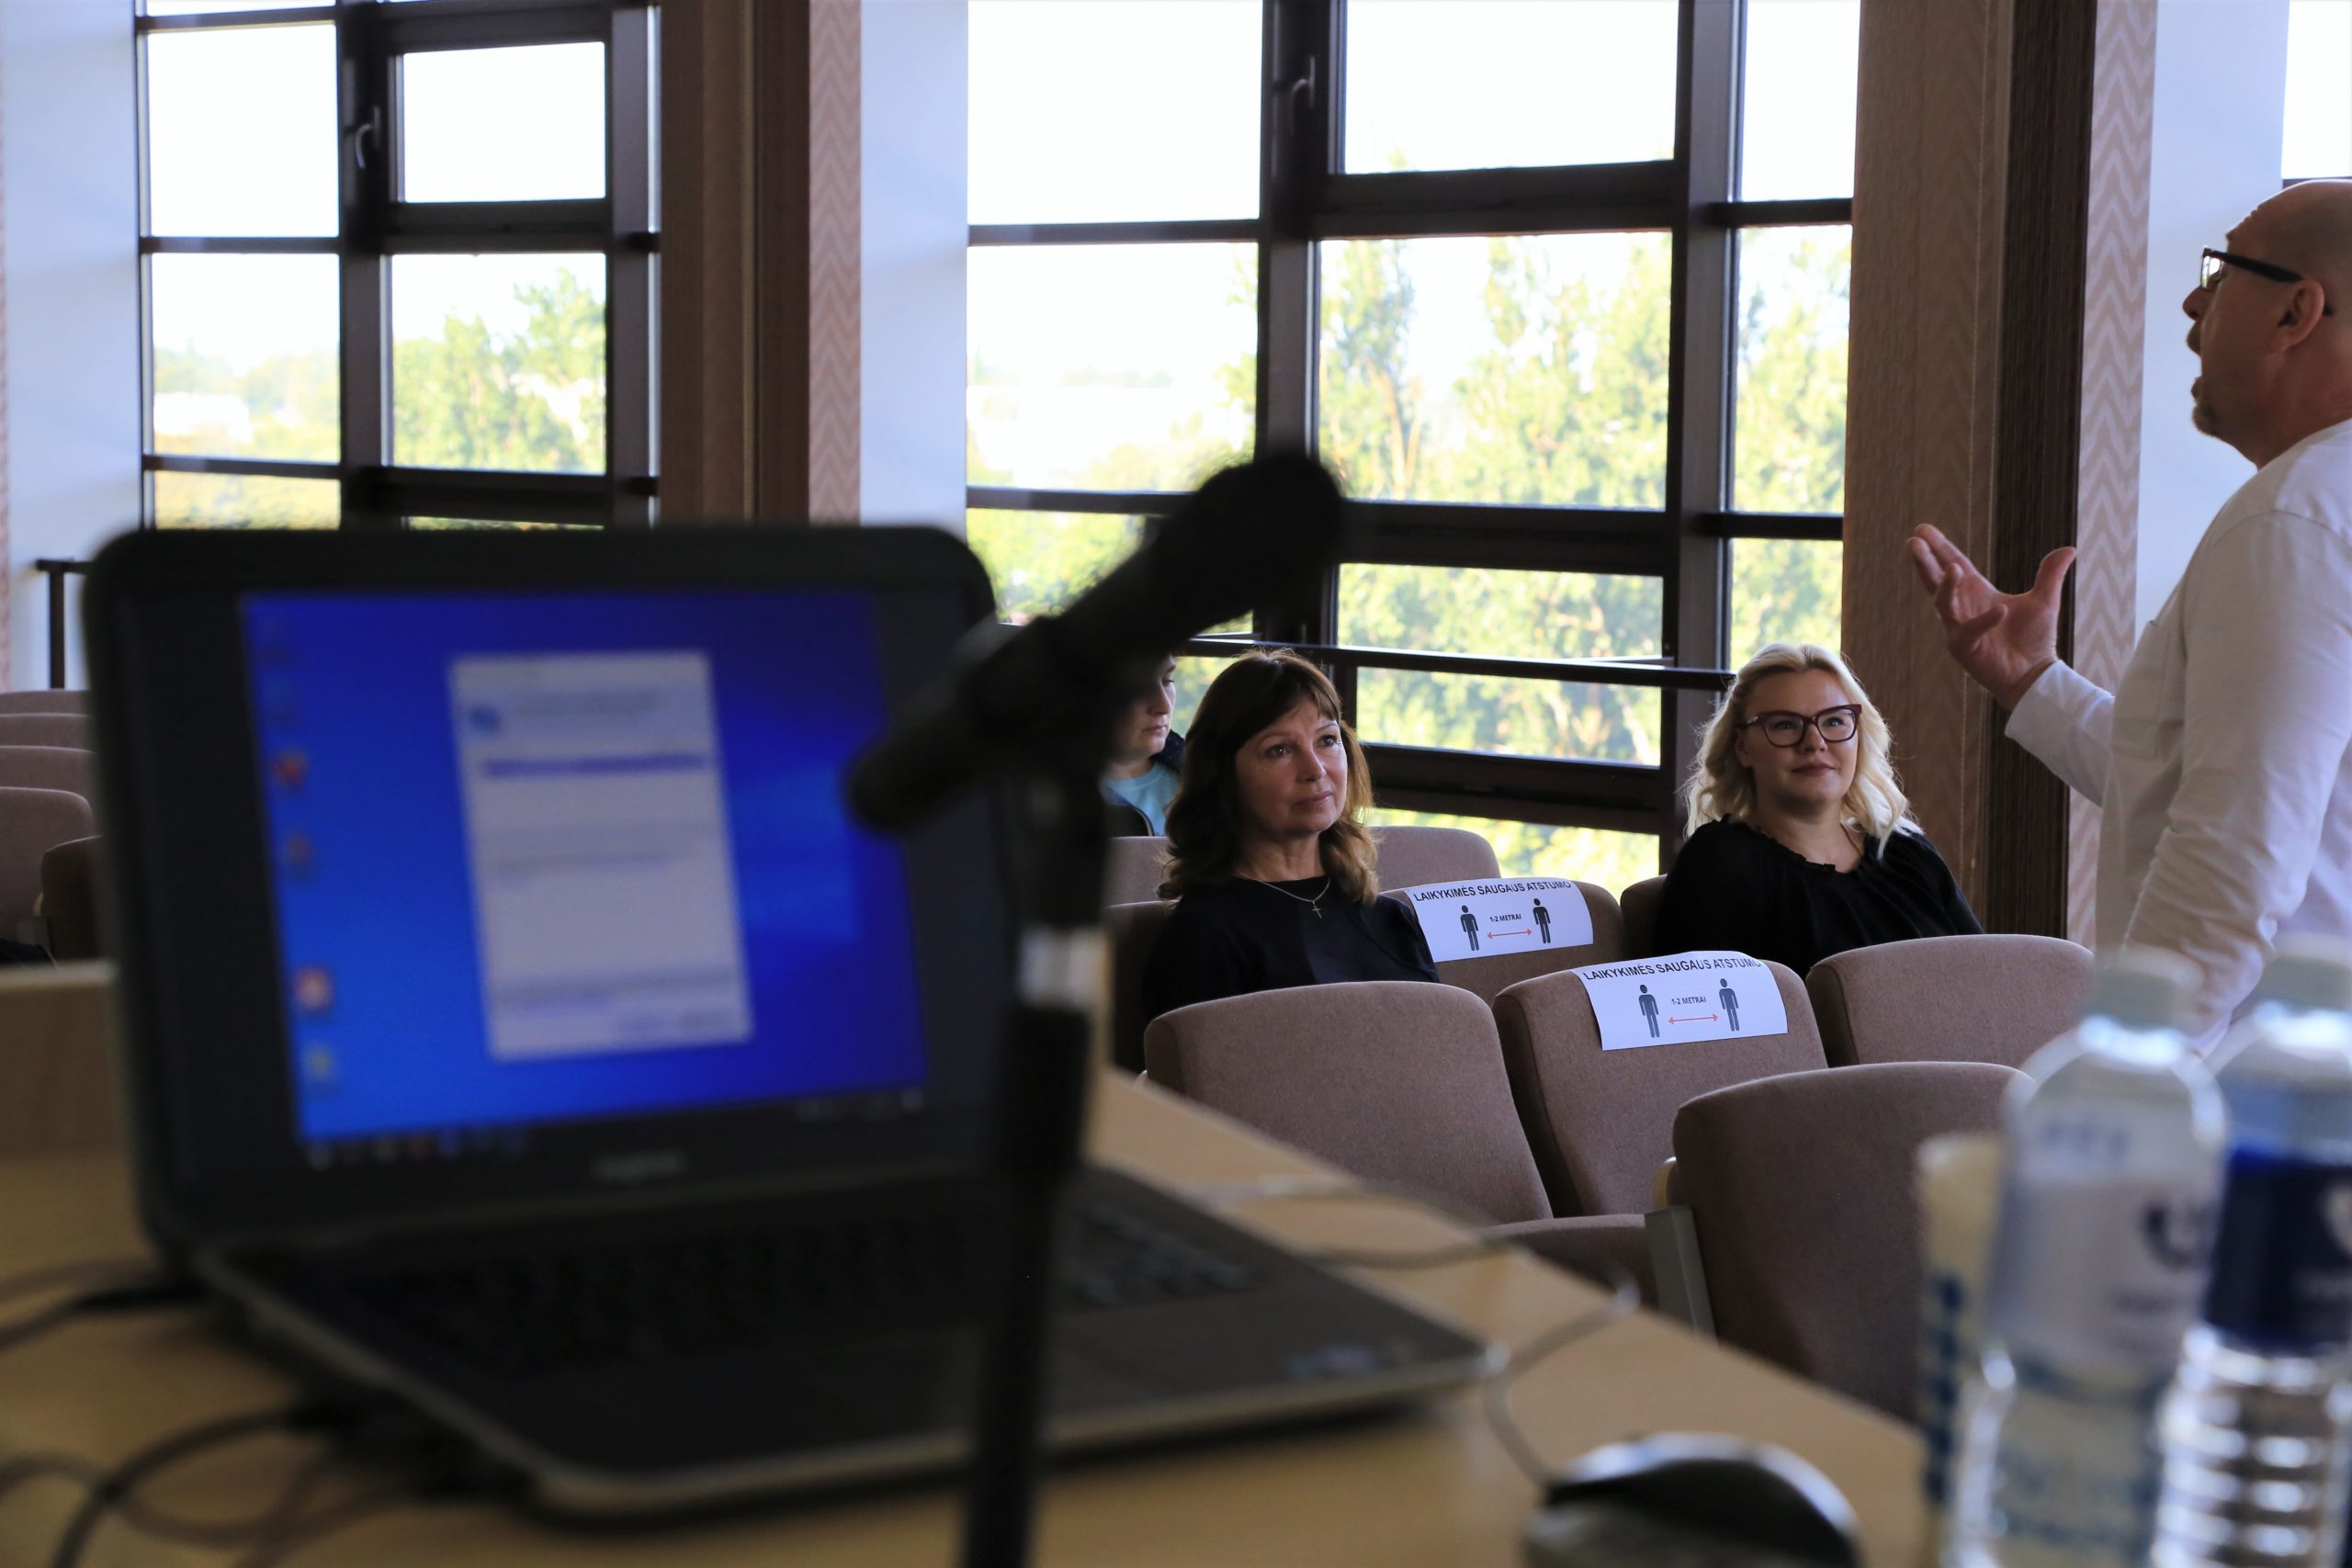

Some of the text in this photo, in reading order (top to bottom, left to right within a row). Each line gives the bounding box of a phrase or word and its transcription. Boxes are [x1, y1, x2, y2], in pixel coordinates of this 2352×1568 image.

[1414, 881, 1572, 902] LAIKYKIMĖS SAUGAUS ATSTUMO
[1499, 914, 1522, 922] METRAI
[1583, 964, 1656, 981] LAIKYKIMĖS
[1657, 959, 1712, 974] SAUGAUS
[1681, 996, 1707, 1004] METRAI
